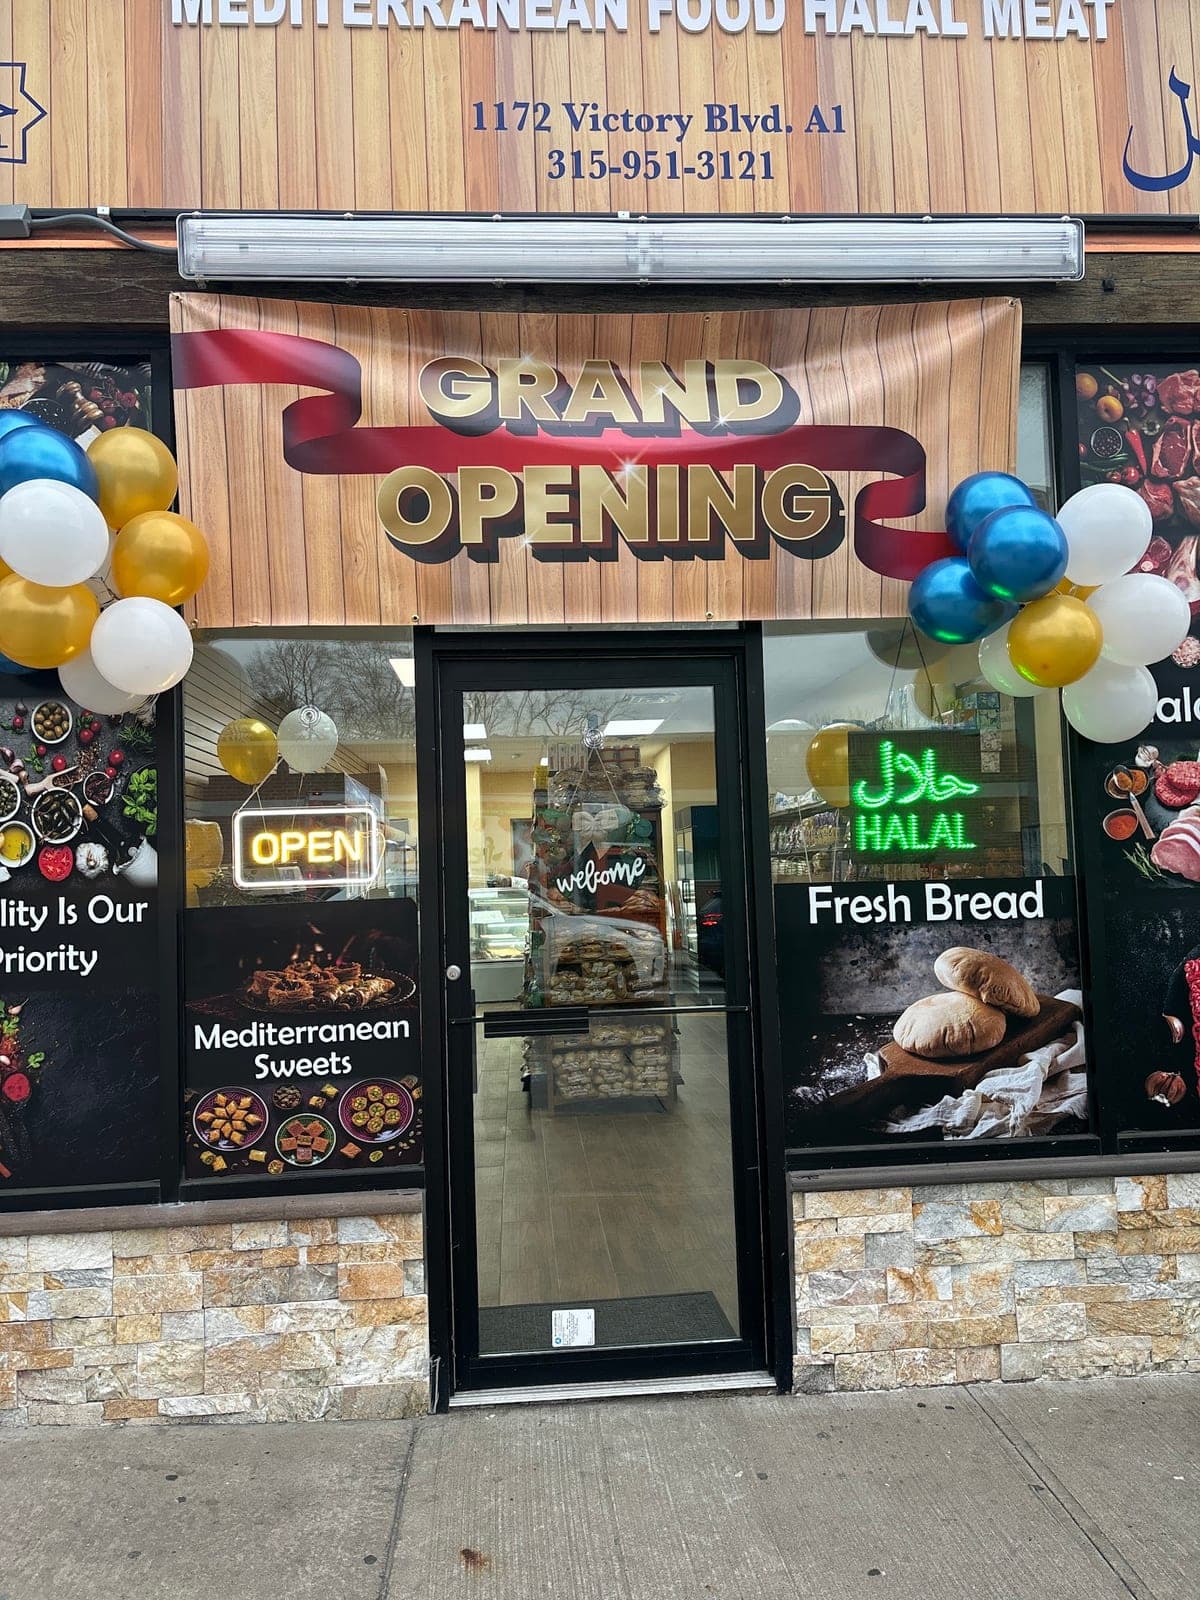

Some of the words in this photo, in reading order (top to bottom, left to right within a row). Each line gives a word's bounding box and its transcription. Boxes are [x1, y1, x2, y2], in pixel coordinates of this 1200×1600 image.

[648, 0, 786, 34] FOOD
[804, 0, 968, 38] HALAL
[983, 0, 1113, 42] MEAT
[473, 101, 551, 131] 1172
[562, 102, 692, 142] Victory
[703, 103, 793, 133] Blvd.
[804, 104, 846, 133] A1
[547, 149, 775, 180] 315-951-3121
[418, 355, 800, 437] GRAND
[376, 463, 846, 564] OPENING
[852, 740, 980, 809] حلال
[250, 828, 363, 866] OPEN
[855, 812, 977, 852] HALAL
[556, 856, 646, 894] welcome
[58, 896, 78, 925] Is
[87, 894, 149, 924] Our
[808, 883, 911, 925] Fresh
[925, 878, 1044, 921] Bread
[194, 1019, 410, 1050] Mediterranean
[254, 1051, 352, 1080] Sweets
